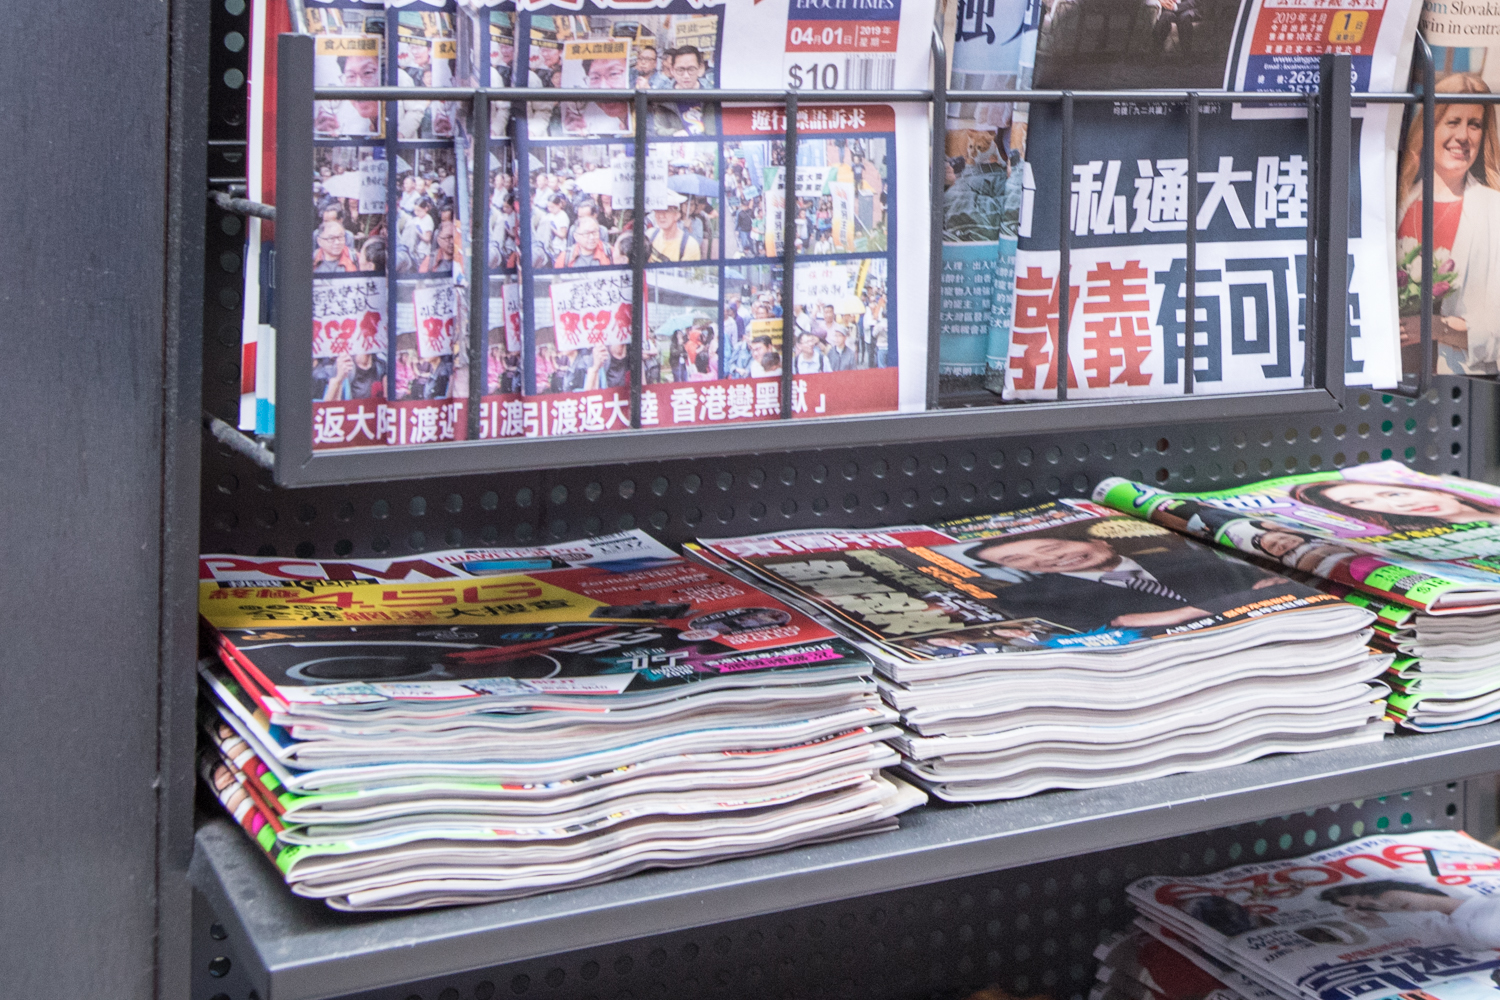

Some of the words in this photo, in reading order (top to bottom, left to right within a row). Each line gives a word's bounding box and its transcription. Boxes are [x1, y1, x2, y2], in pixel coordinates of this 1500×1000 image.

[1448, 19, 1461, 35] in
[787, 63, 839, 90] $10
[1070, 155, 1309, 235] 私通大陸
[199, 554, 465, 581] PCM
[285, 580, 543, 611] 4.5G
